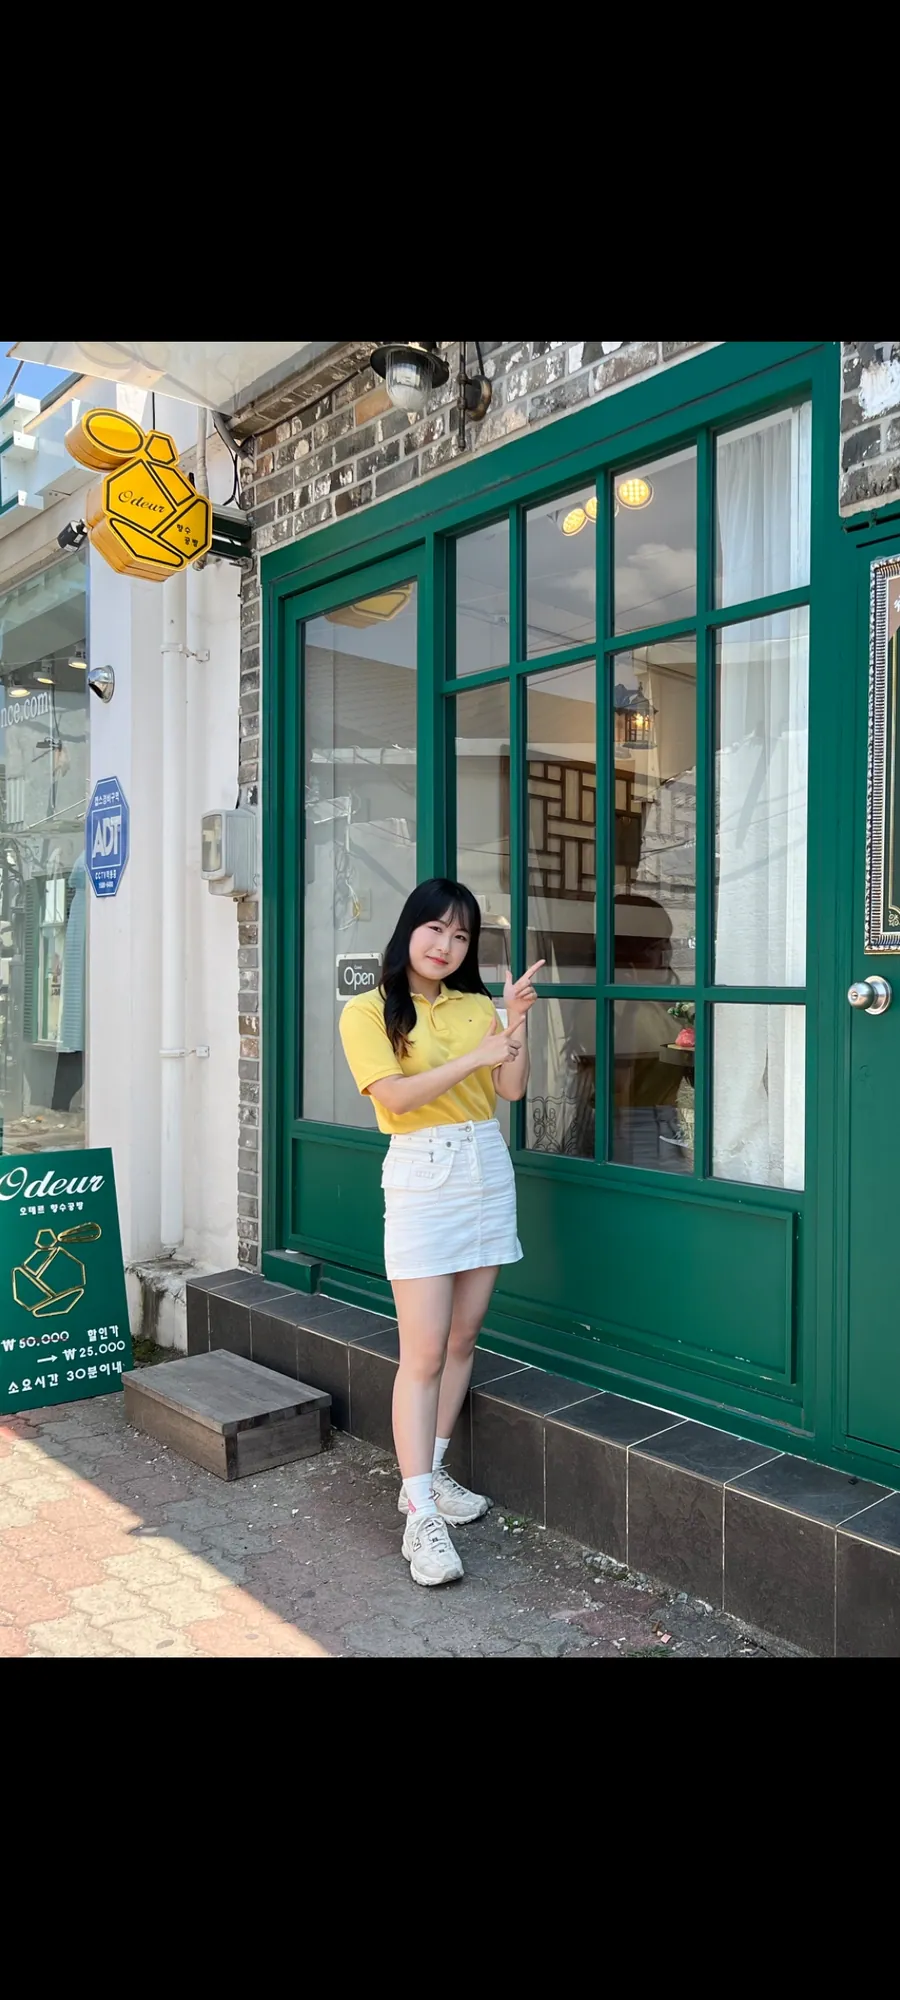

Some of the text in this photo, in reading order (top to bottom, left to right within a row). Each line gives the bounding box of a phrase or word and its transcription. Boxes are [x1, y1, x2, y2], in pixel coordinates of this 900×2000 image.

[118, 490, 166, 513] Odeur
[92, 815, 121, 858] ADT
[344, 967, 374, 990] Open
[0, 1166, 105, 1201] Odeur
[50, 1201, 84, 1213] 향수공방
[87, 1324, 119, 1342] 할인가
[8, 1360, 123, 1395] 소요시간 30분이내
